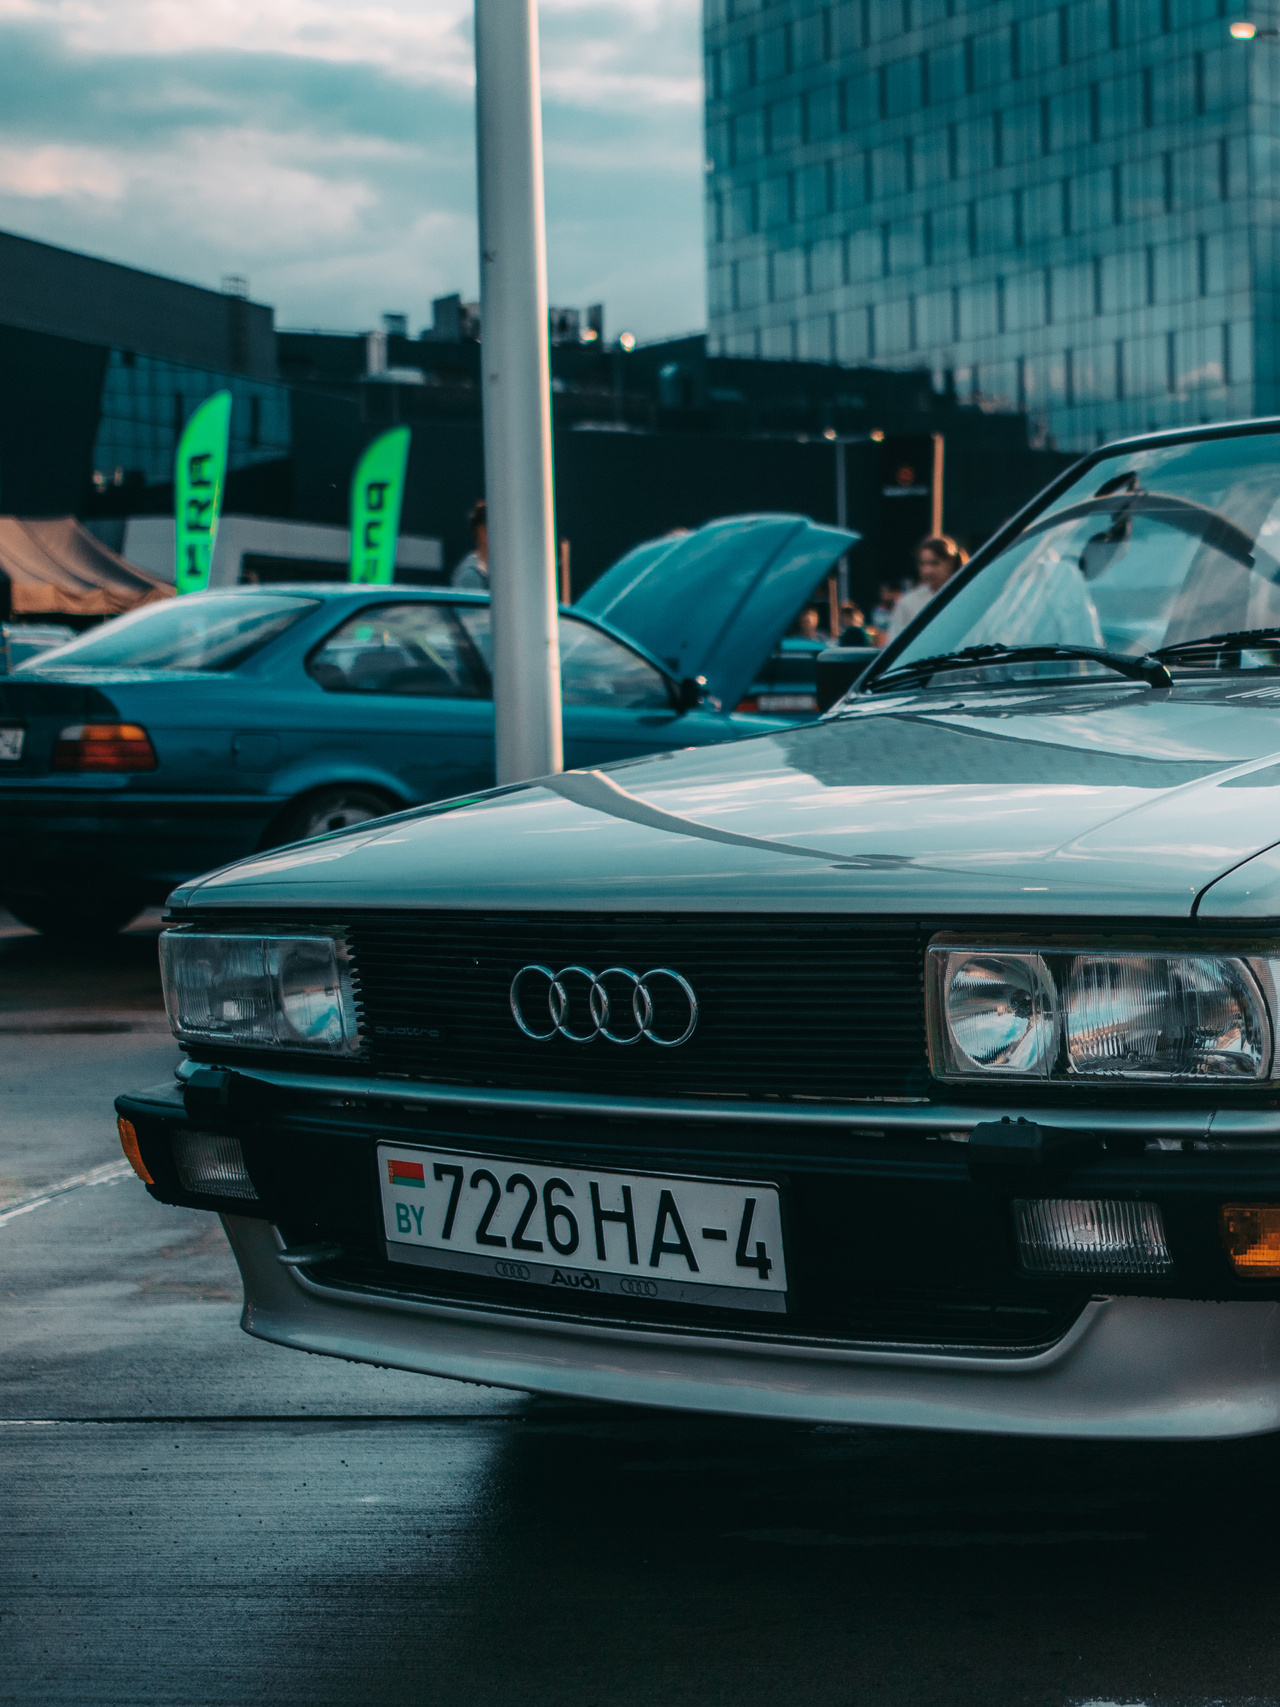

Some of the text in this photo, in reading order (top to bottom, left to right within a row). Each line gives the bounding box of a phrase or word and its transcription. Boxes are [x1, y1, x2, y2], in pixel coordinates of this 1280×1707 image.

[375, 1025, 440, 1038] quattro
[395, 1202, 425, 1236] BY
[550, 1269, 600, 1291] Audi
